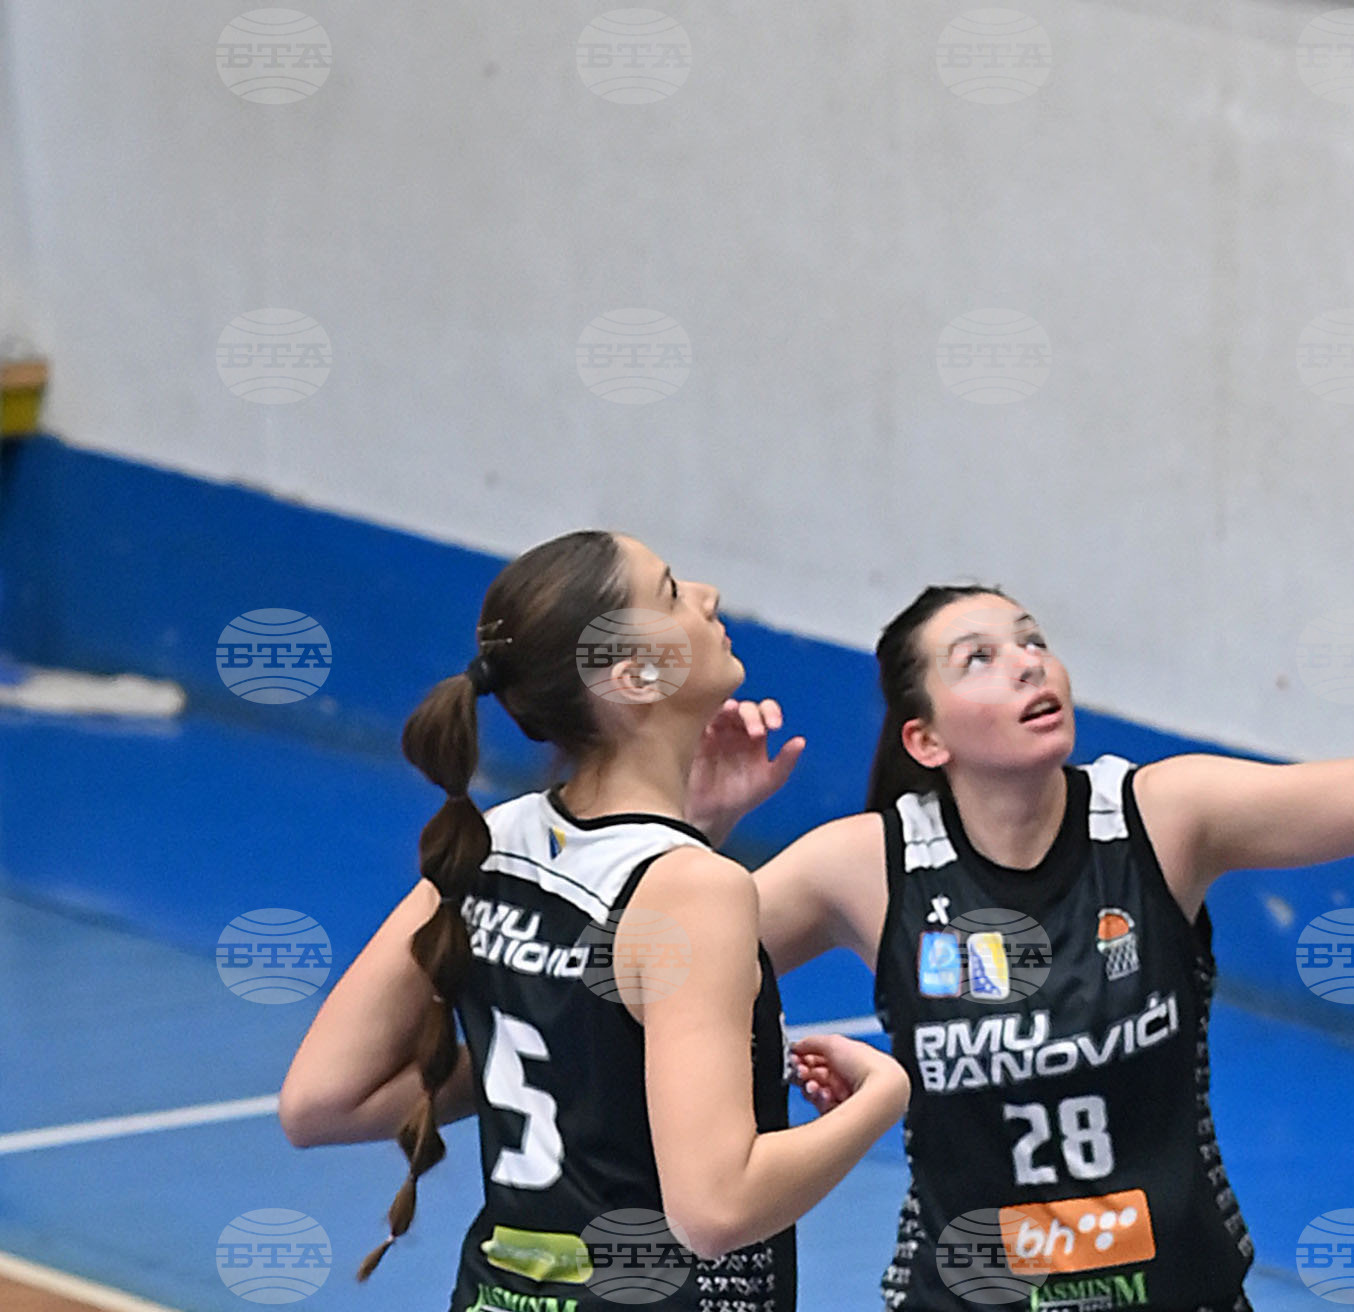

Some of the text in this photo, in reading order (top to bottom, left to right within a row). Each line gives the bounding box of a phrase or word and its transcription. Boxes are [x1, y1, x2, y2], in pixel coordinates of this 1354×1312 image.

[914, 1010, 1050, 1061] RMU
[918, 992, 1179, 1092] BANOVIĆI
[483, 1006, 565, 1191] 5
[1003, 1094, 1115, 1186] 28
